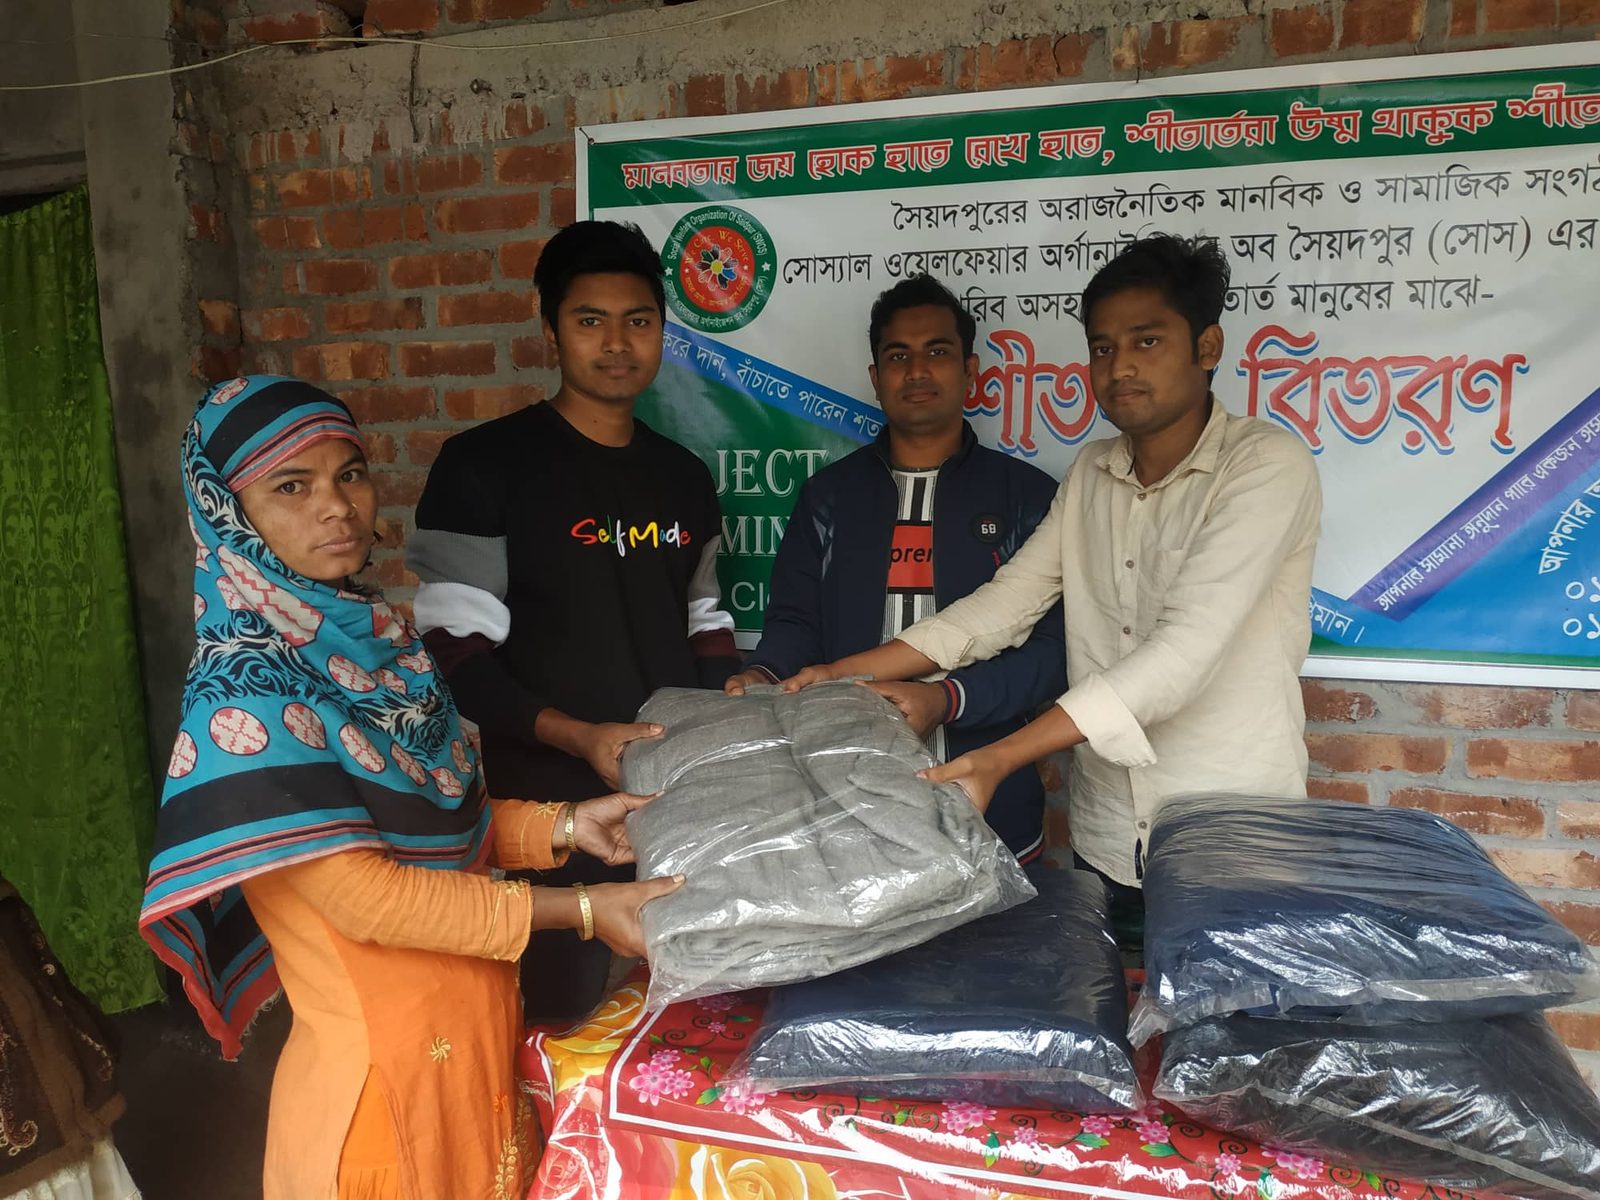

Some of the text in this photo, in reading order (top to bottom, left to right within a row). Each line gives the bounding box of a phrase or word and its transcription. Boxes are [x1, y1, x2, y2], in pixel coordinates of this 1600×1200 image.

[621, 155, 739, 189] মানবতার
[746, 151, 796, 181] জয়
[807, 143, 877, 180] হোক
[884, 138, 953, 173] হাতে
[965, 132, 1031, 168] রেখে
[1038, 126, 1115, 167] হাত,
[1124, 109, 1279, 153] শীতার্তরা
[1372, 100, 1497, 146] থাকুক
[667, 239, 681, 260] Social
[690, 209, 728, 225] Organization
[728, 211, 737, 221] Of
[890, 200, 1029, 233] সৈয়দপুরের
[1038, 182, 1206, 222] অরাজনৈতিক
[1216, 175, 1325, 212] মানবিক
[1338, 181, 1361, 204] ও
[1375, 163, 1512, 203] সামাজিক
[783, 251, 872, 284] সোস্যাল
[883, 243, 1029, 279] ওয়েলফেয়ার
[1230, 233, 1279, 263] অব
[1287, 222, 1414, 267] সৈয়দপুর
[1428, 215, 1531, 266] (সোস)
[1548, 219, 1599, 250] এর
[960, 286, 1007, 322] রিব
[1287, 280, 1394, 321] মানুষের
[696, 346, 728, 380] দান,
[737, 358, 793, 399] বাঁচাতে
[798, 390, 848, 424] পারেন
[853, 411, 883, 436] শত
[1235, 324, 1530, 455] বিতরণ
[1374, 567, 1424, 611] আপনার
[1459, 497, 1509, 539] অনুদান
[1533, 437, 1581, 479] একজন
[1538, 499, 1596, 575] আপনার
[731, 581, 769, 611] Cl
